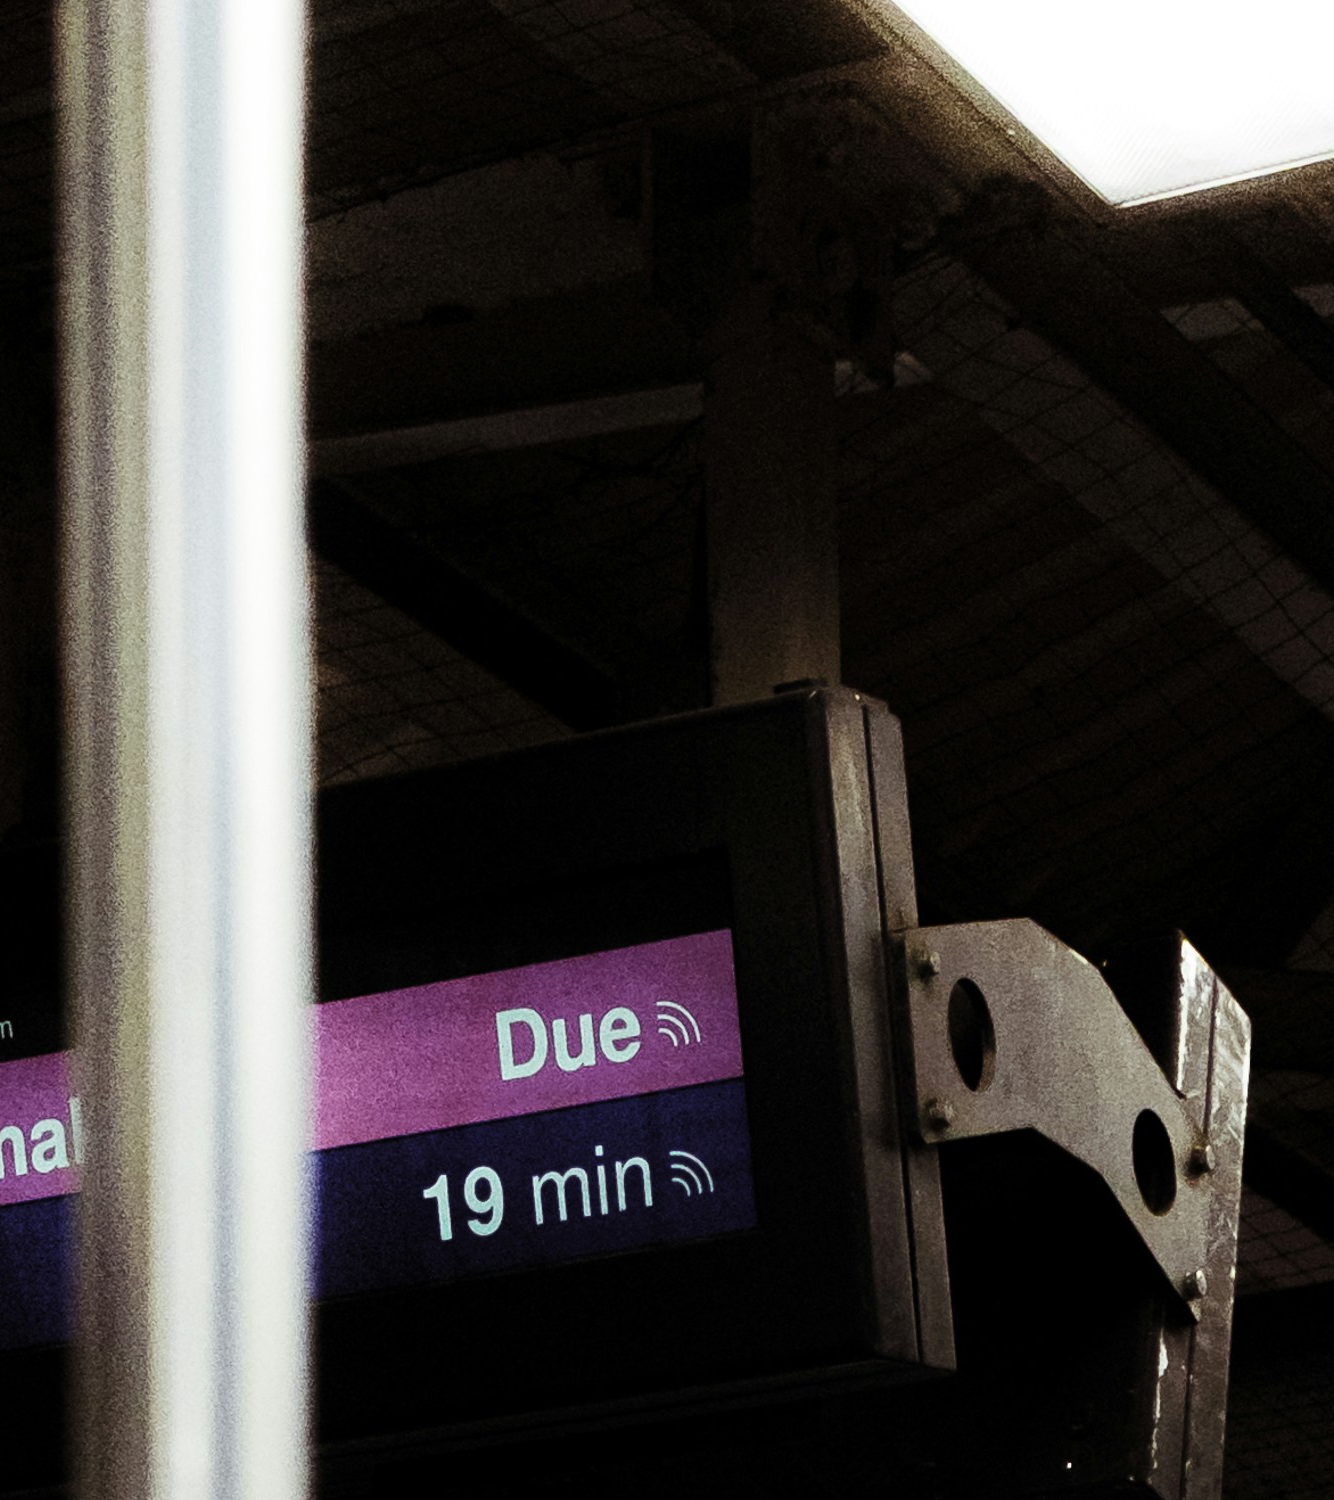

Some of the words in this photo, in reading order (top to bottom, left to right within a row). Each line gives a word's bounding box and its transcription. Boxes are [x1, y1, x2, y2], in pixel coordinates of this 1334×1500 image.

[495, 1006, 641, 1081] Due
[423, 1166, 504, 1241] 19
[532, 1145, 653, 1225] min
